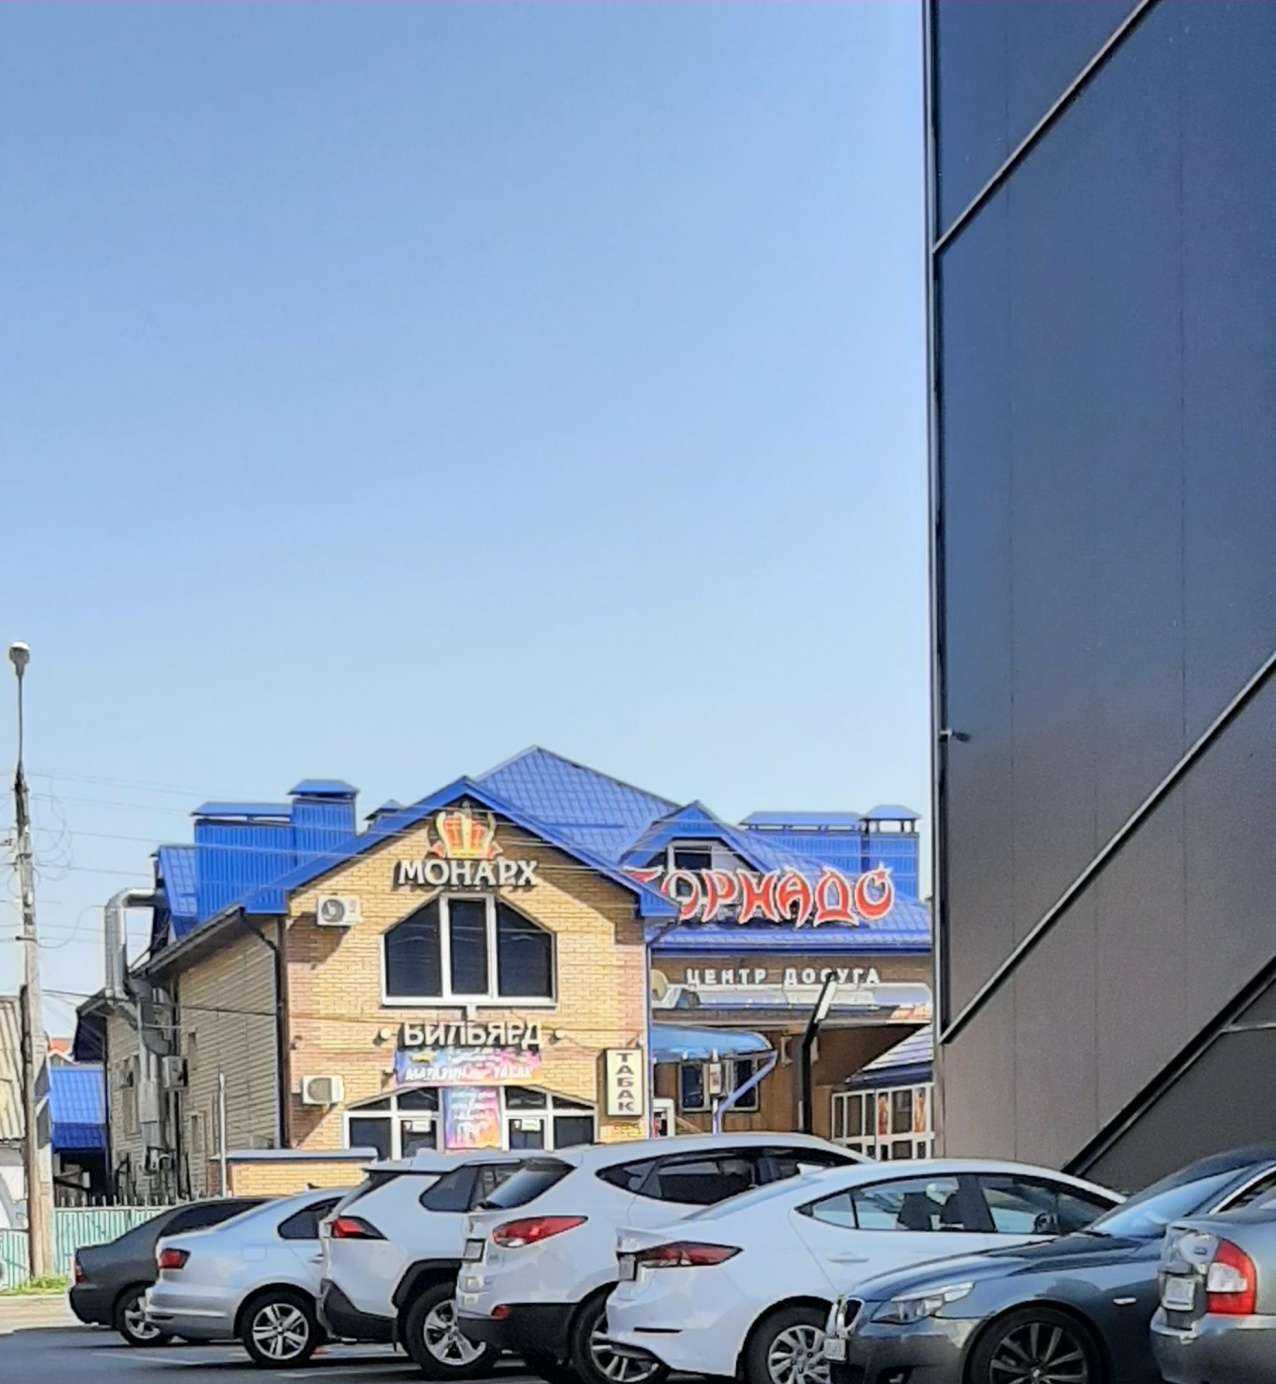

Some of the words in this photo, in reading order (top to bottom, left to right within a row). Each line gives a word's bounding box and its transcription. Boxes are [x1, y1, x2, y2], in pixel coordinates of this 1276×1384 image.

[398, 857, 538, 886] МОНАРХ
[685, 967, 767, 988] ЦЕНТР
[784, 967, 881, 987] ДОСУГА
[404, 1021, 544, 1049] БИЛЬЯРД
[616, 1052, 635, 1112] ТАБАК
